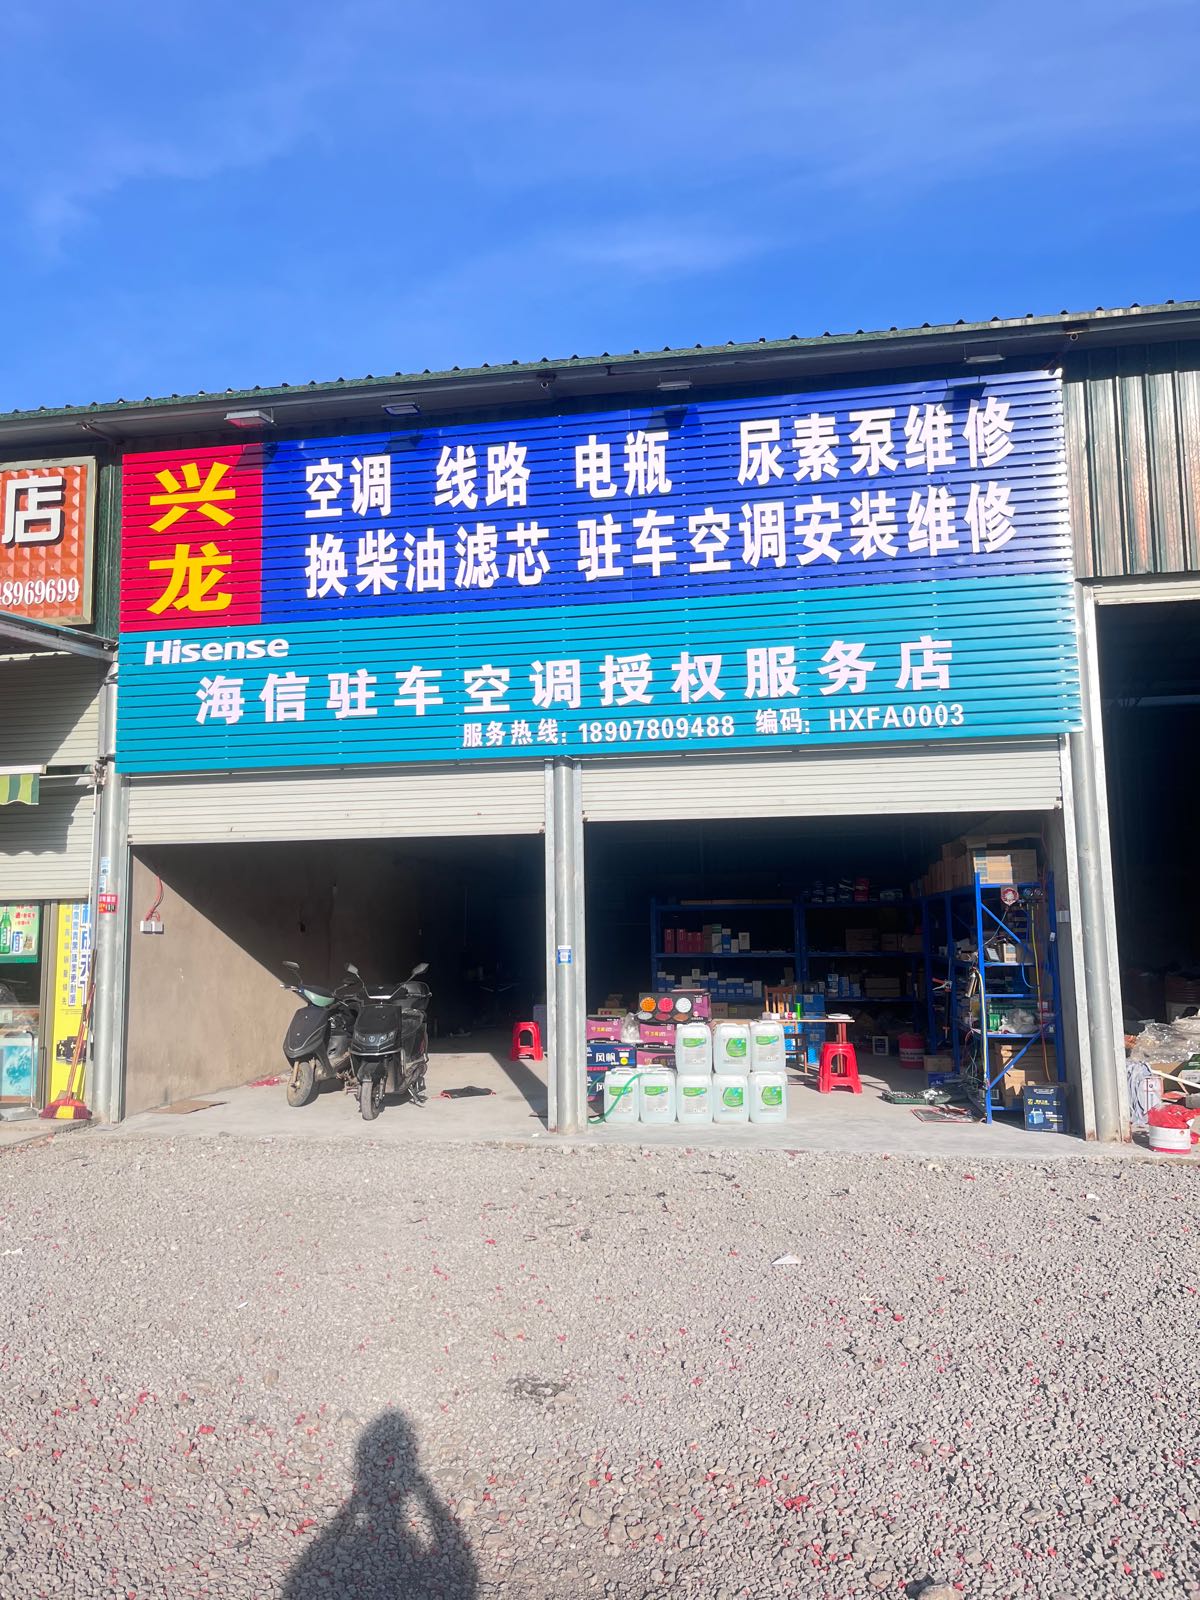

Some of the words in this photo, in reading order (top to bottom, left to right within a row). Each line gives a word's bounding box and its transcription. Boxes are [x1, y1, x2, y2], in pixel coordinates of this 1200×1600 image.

[305, 455, 391, 519] 空调
[434, 441, 531, 510] 线路
[575, 430, 673, 499] 电瓶
[737, 396, 1015, 487] 尿素泵维修
[1, 475, 63, 544] 店
[147, 461, 236, 615] 兴龙
[304, 520, 551, 599] 换柴油滤芯
[576, 482, 1017, 582] 驻车空调安装维修
[144, 637, 290, 666] Hisense
[195, 635, 954, 726] 海信驻车空调授权服务店
[579, 715, 735, 743] 18907809488
[829, 703, 965, 731] HXFA0003
